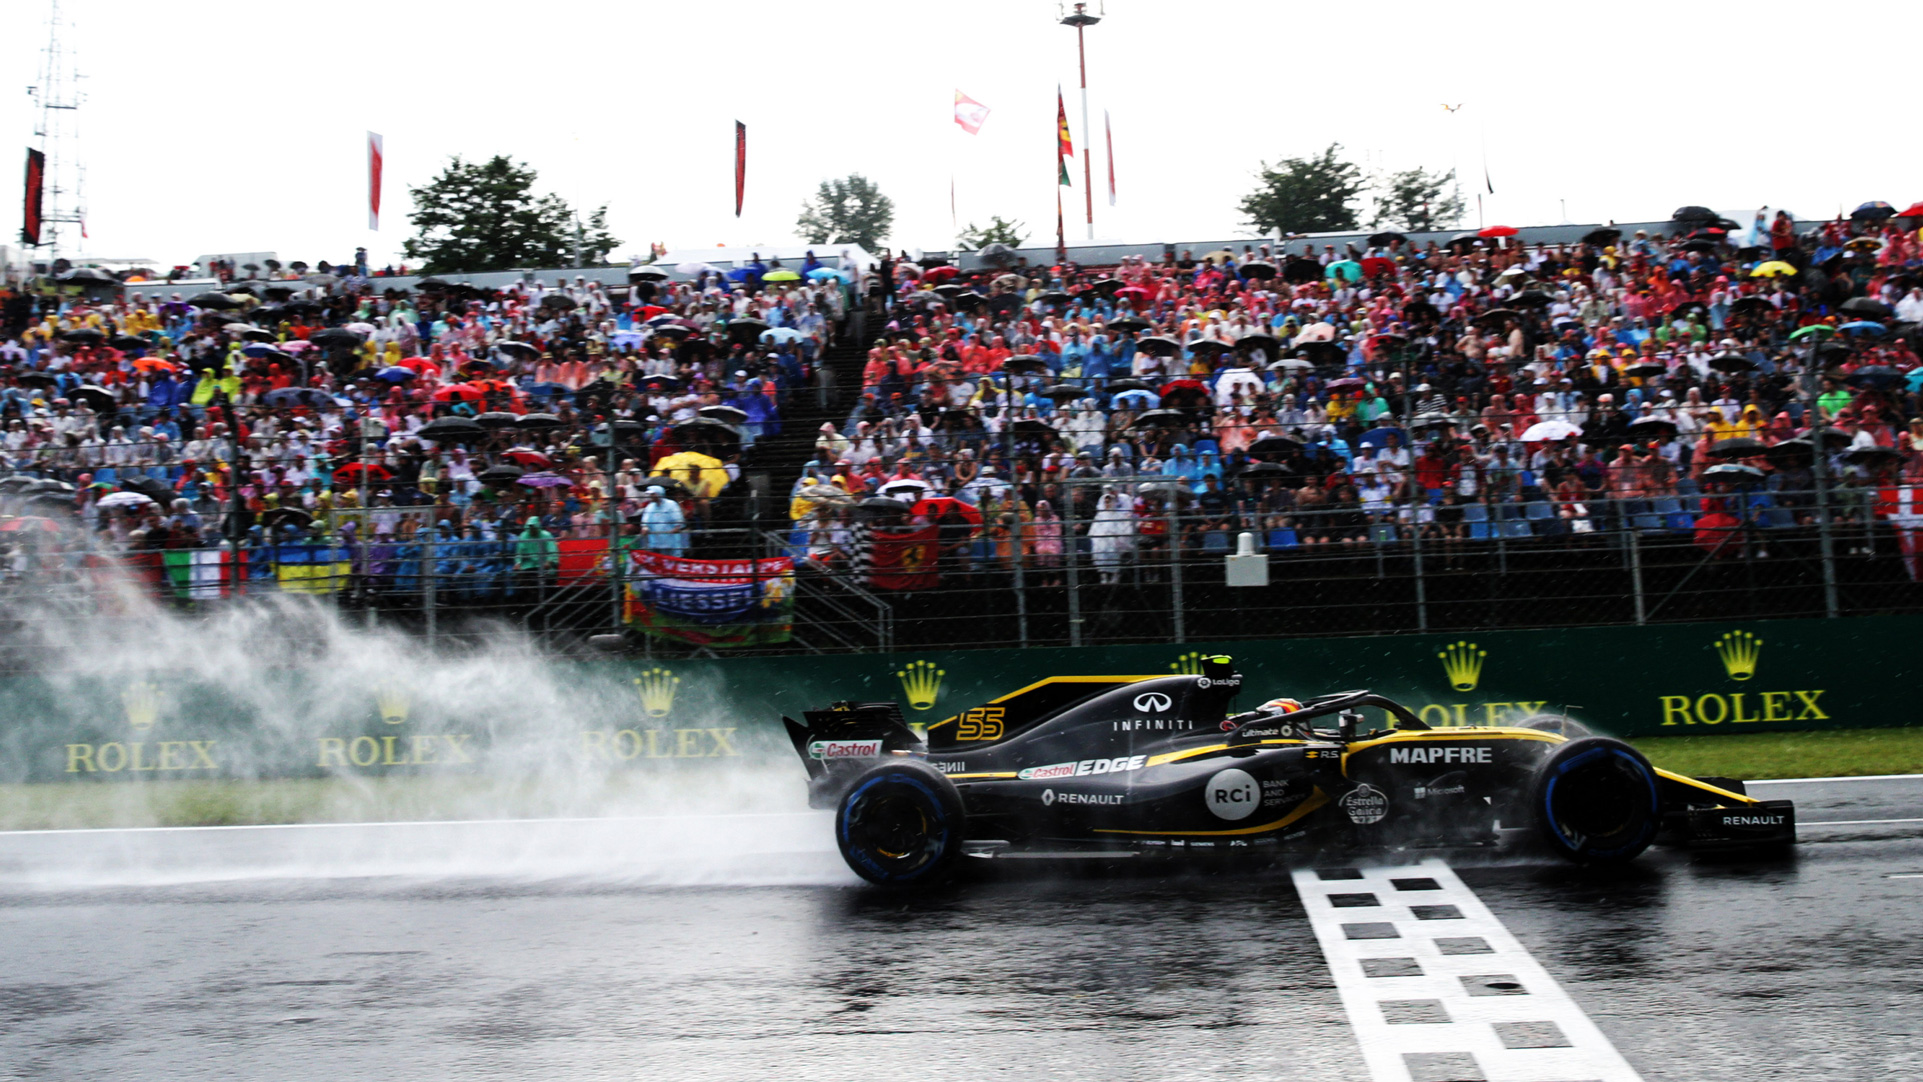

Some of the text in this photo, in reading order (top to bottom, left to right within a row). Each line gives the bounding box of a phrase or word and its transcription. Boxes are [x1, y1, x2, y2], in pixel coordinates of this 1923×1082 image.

[1659, 690, 1831, 726] ROLEX
[956, 707, 1005, 741] 55
[1113, 720, 1193, 731] INFINITI
[316, 734, 474, 767] ROLEX
[580, 727, 741, 760] ROLEX
[827, 743, 877, 757] Castrol
[65, 741, 218, 773] ROLEX
[1390, 747, 1493, 764] MAPFRE
[1033, 755, 1147, 778] Castrol EDGE
[1427, 785, 1465, 794] Microsoft
[1058, 793, 1124, 805] RENAULT
[1346, 796, 1383, 806] Estrella
[1723, 816, 1785, 825] RENAULT
